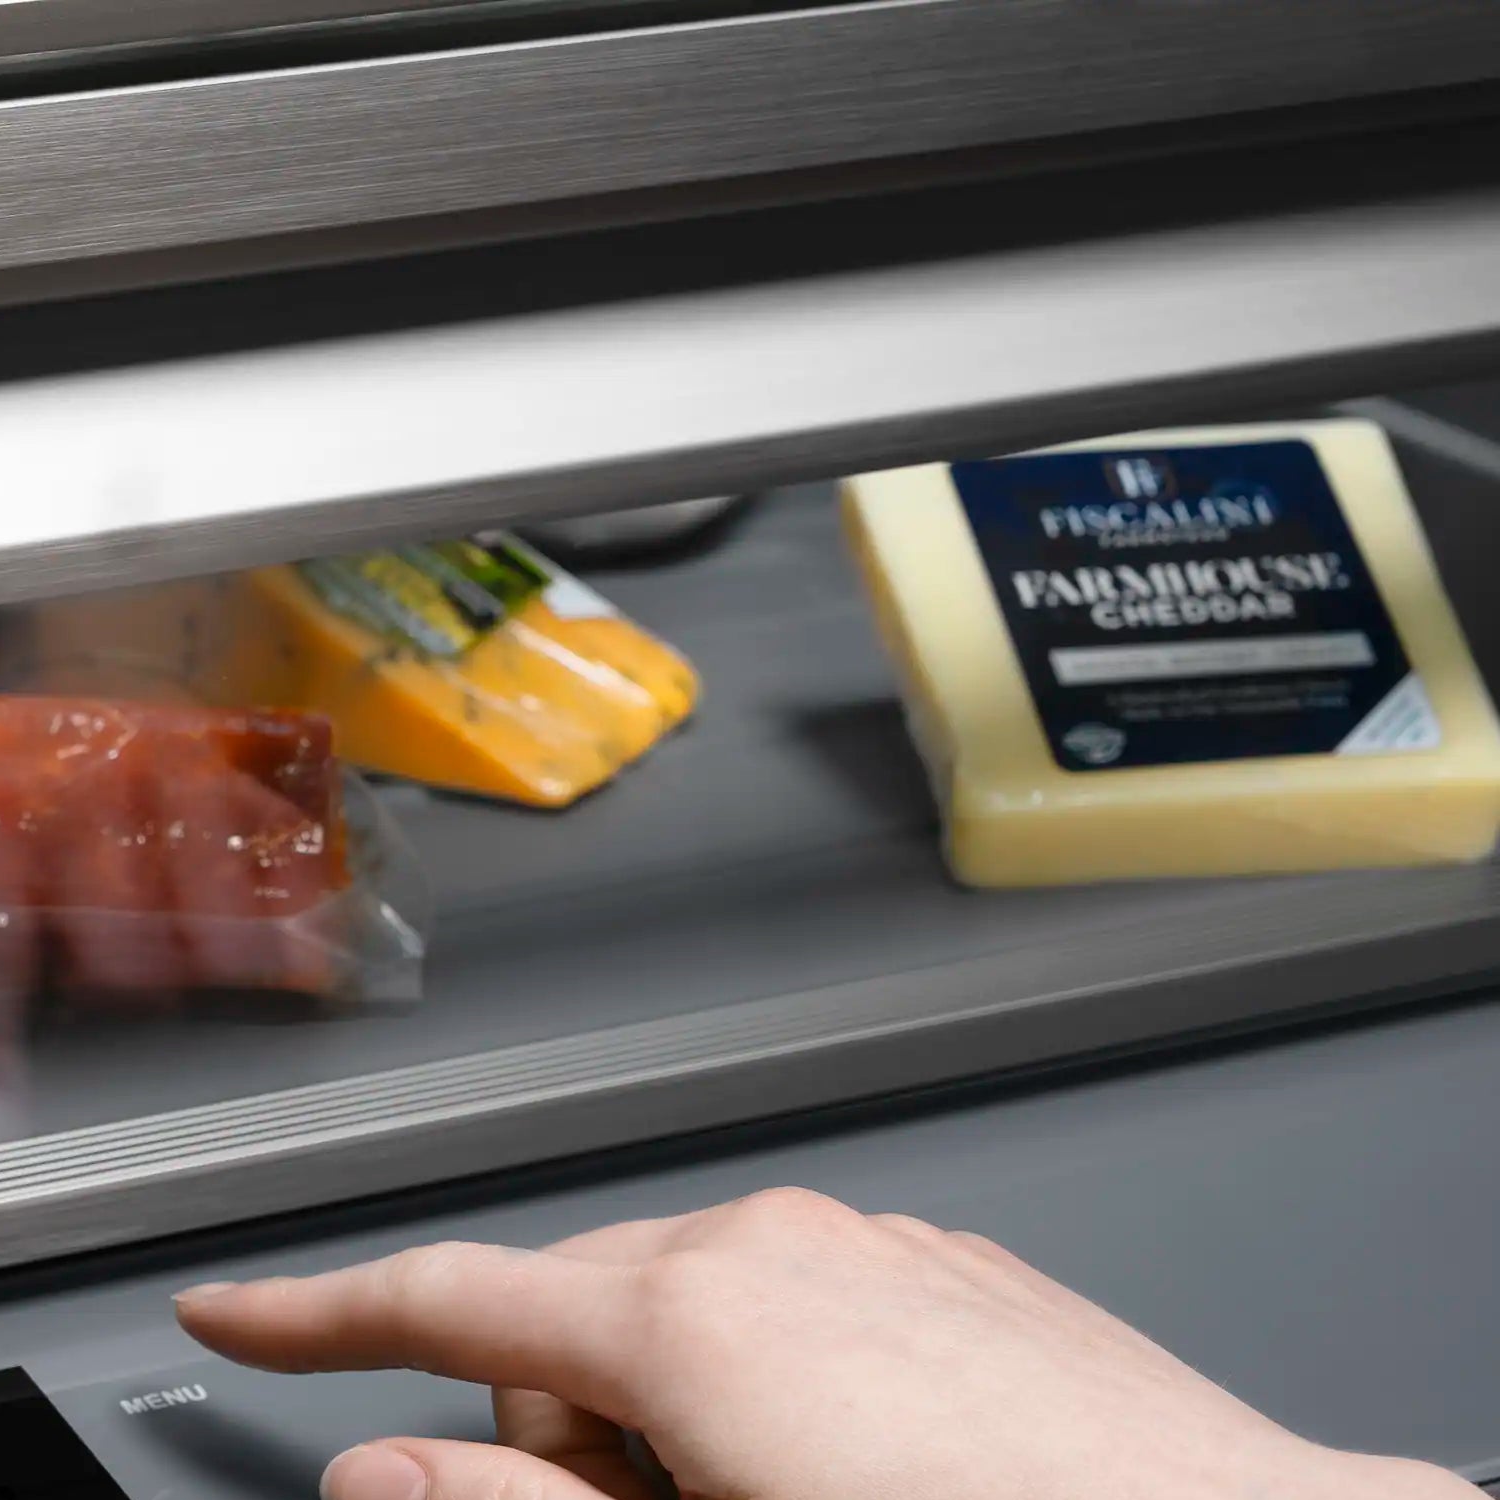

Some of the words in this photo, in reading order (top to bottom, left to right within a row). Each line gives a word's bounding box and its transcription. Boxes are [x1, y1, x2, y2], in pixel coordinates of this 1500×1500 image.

[1039, 494, 1274, 539] FISCALINI
[1012, 552, 1350, 609] FARMHOUSE
[1091, 591, 1295, 630] CHEDDAR
[120, 1383, 208, 1415] MENU
